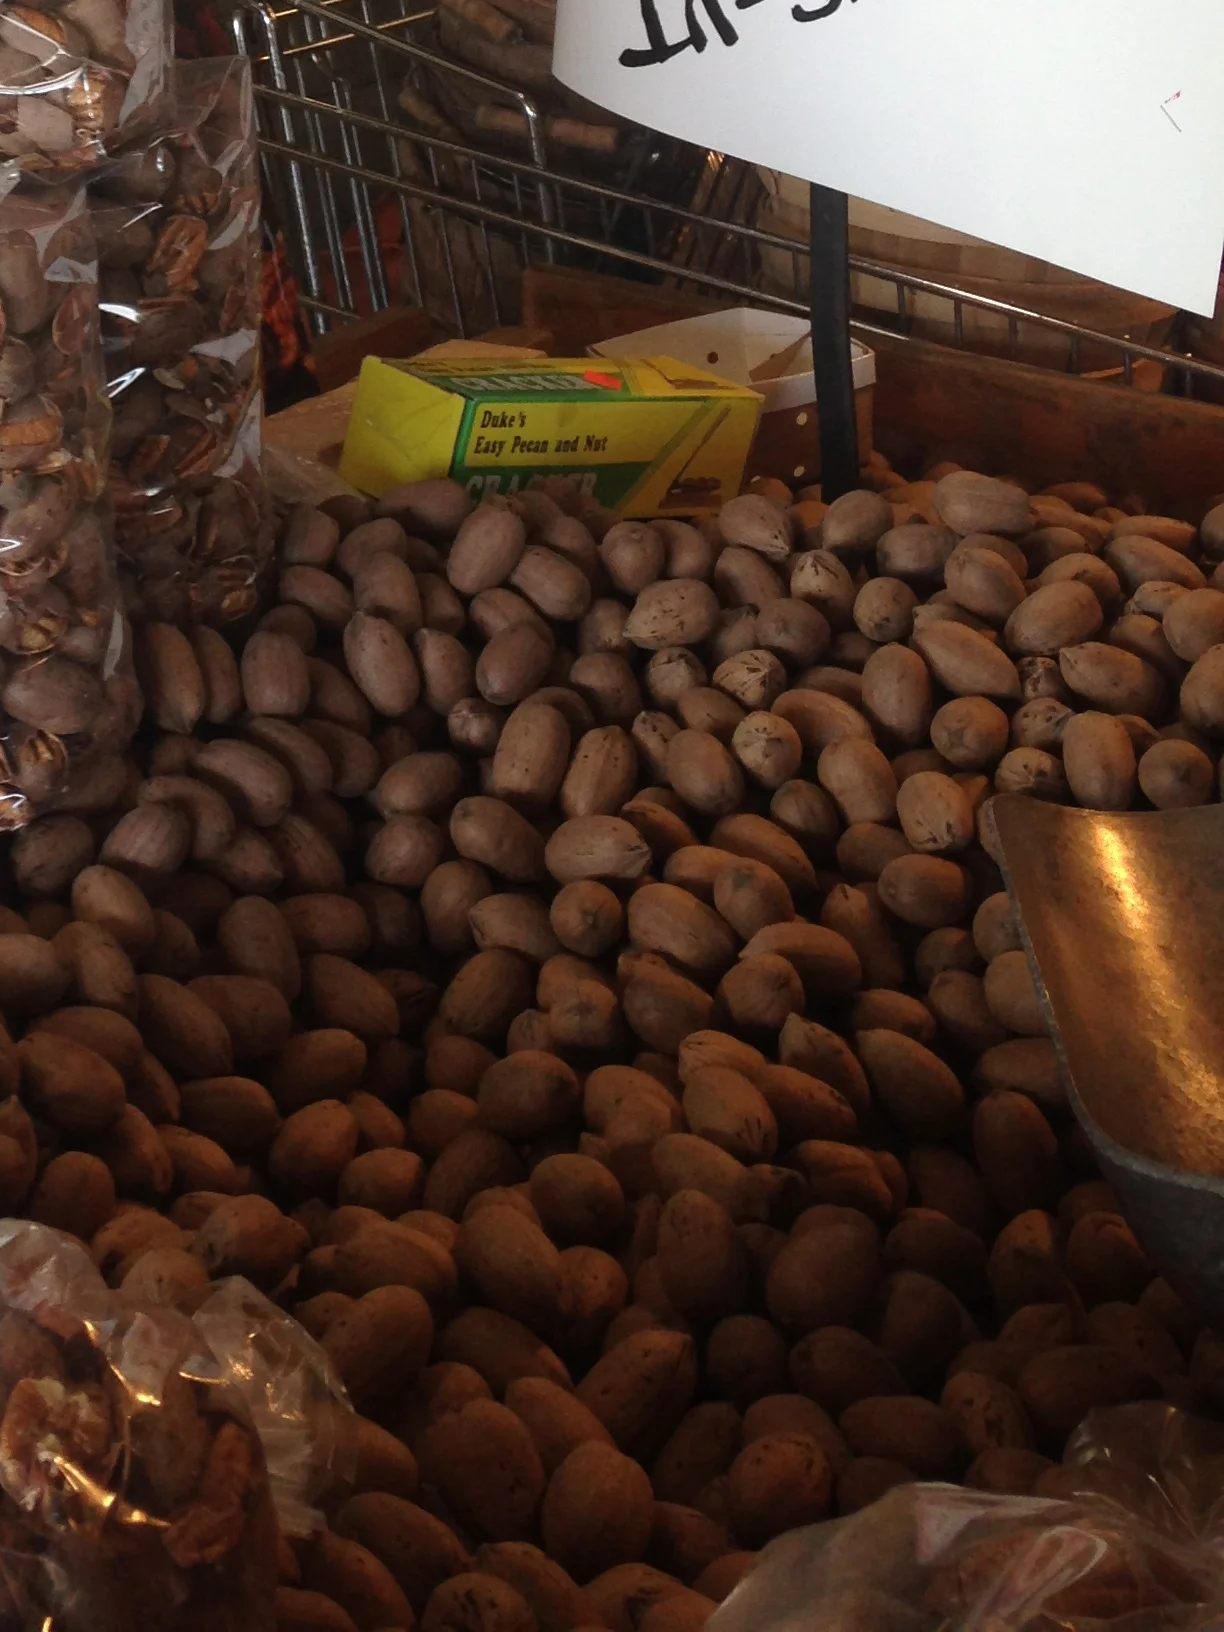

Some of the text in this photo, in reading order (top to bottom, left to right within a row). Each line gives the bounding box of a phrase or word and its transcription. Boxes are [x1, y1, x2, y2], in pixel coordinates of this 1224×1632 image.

[480, 410, 527, 429] Duke's
[473, 434, 608, 457] Easy Pecan and Nut
